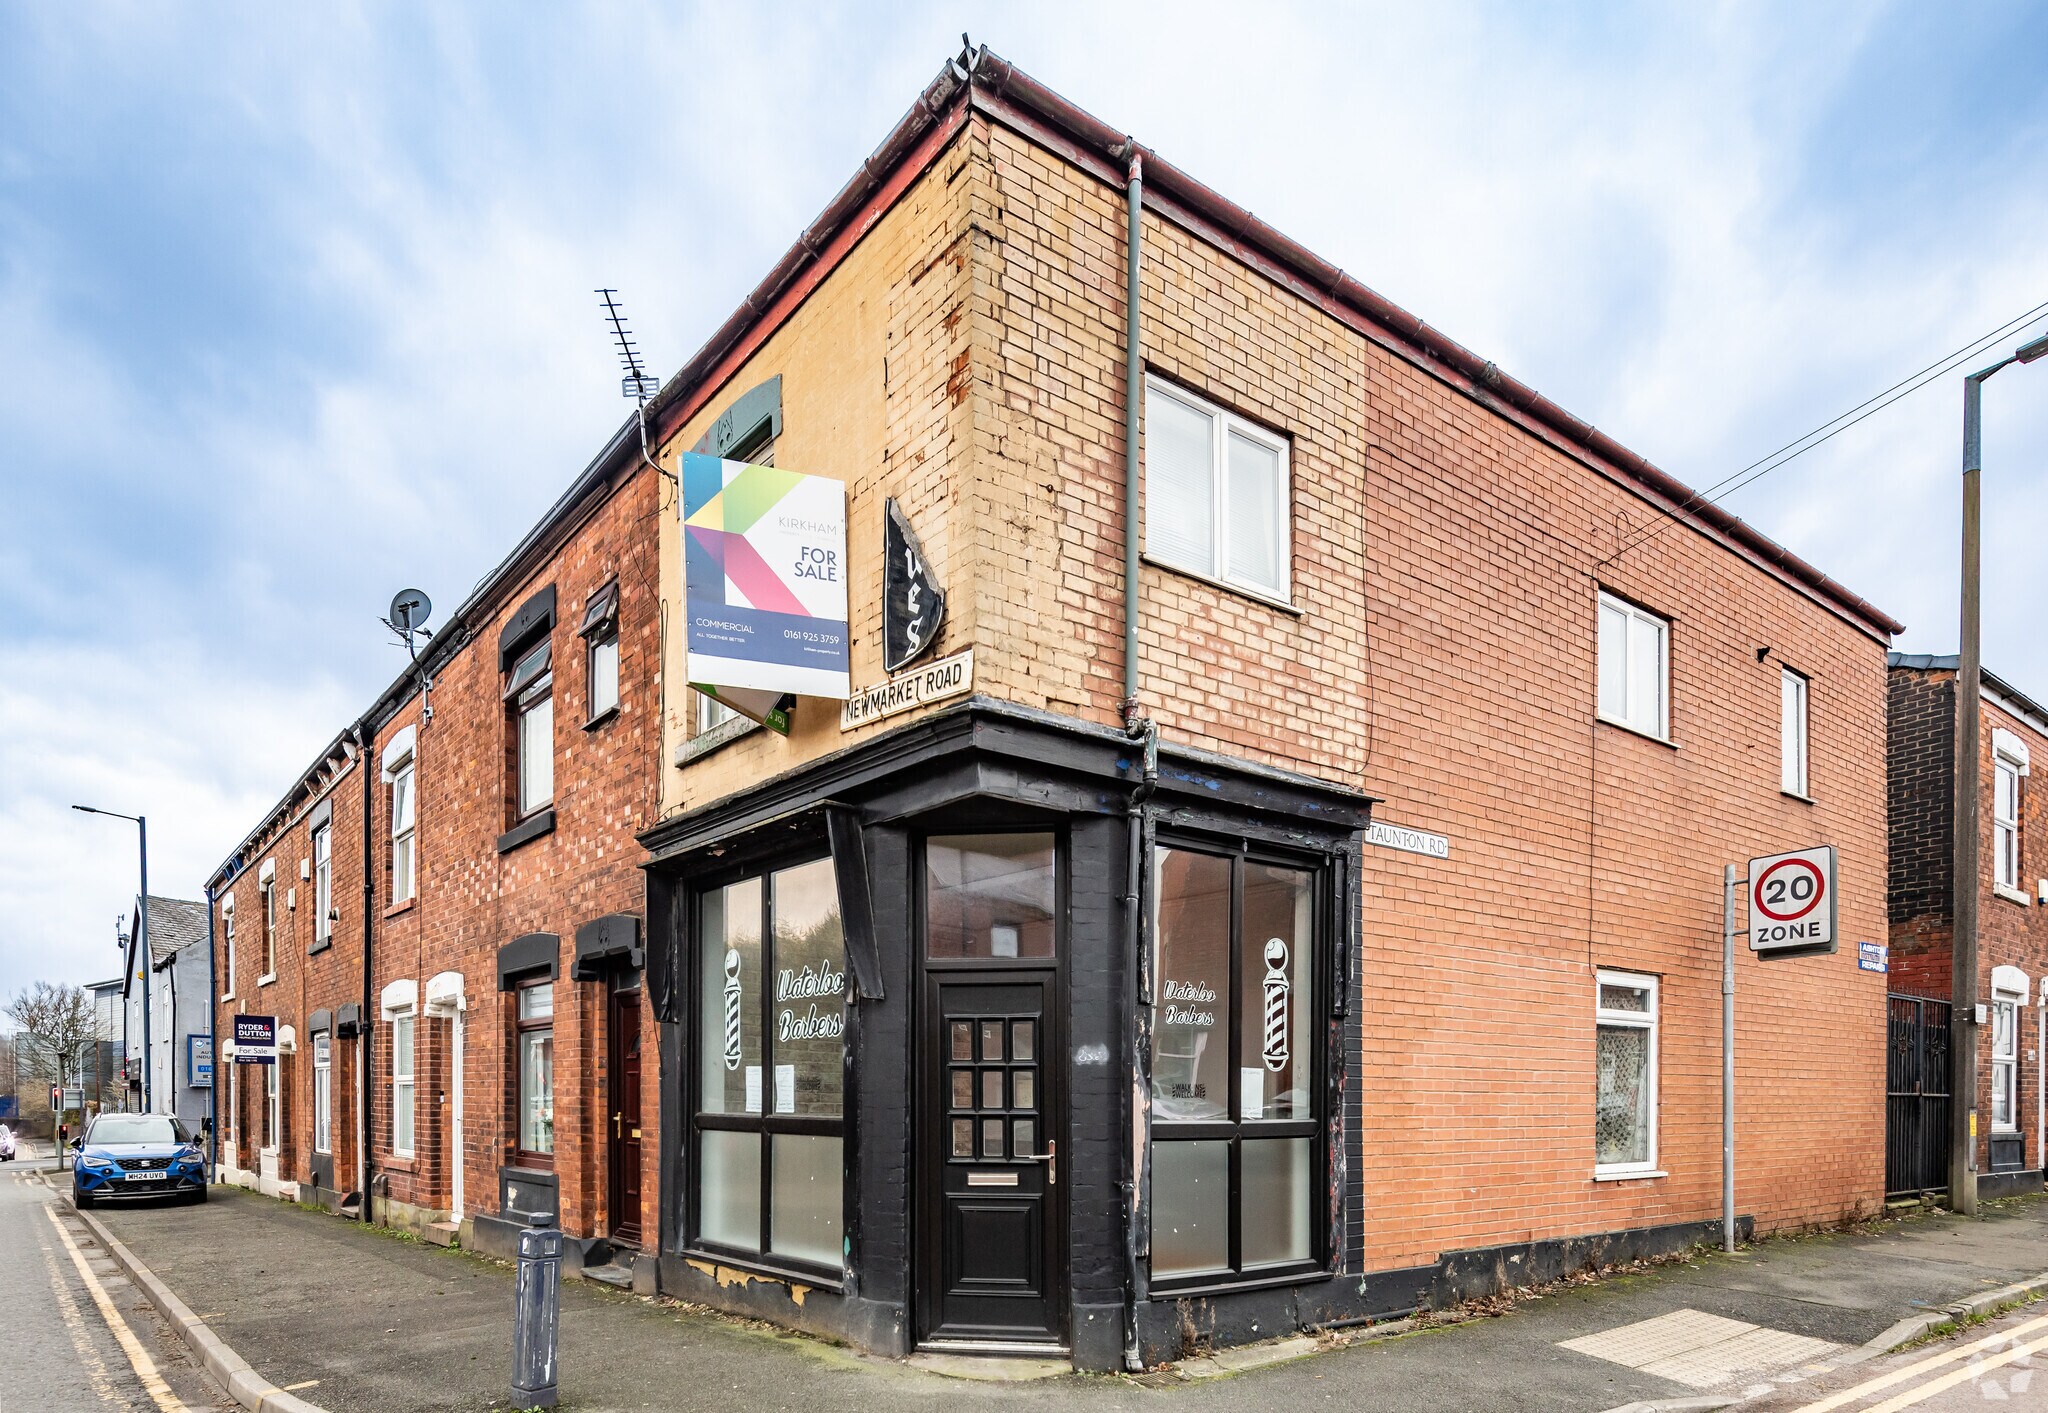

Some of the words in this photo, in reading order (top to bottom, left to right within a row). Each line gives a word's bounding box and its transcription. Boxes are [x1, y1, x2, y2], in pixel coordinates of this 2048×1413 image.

[779, 516, 837, 536] KIRKHAM
[801, 546, 837, 566] FOR
[794, 561, 837, 582] SALE
[696, 617, 754, 634] COMMERCIAL
[706, 633, 728, 641] TOGETHER
[783, 629, 801, 639] 0161
[802, 631, 819, 642] 925
[820, 634, 840, 645] 3759
[846, 675, 922, 722] NEWMARKET
[926, 663, 962, 694] ROAD
[1370, 825, 1425, 850] TAUNTON
[1766, 875, 1813, 905] 20
[1757, 922, 1821, 943] ZONE
[1862, 943, 1886, 956] ASHTO
[777, 959, 844, 1001] Waterloo
[1164, 980, 1216, 1002] Waterloo
[779, 1003, 843, 1042] Barbers
[1165, 1004, 1214, 1025] Barbers
